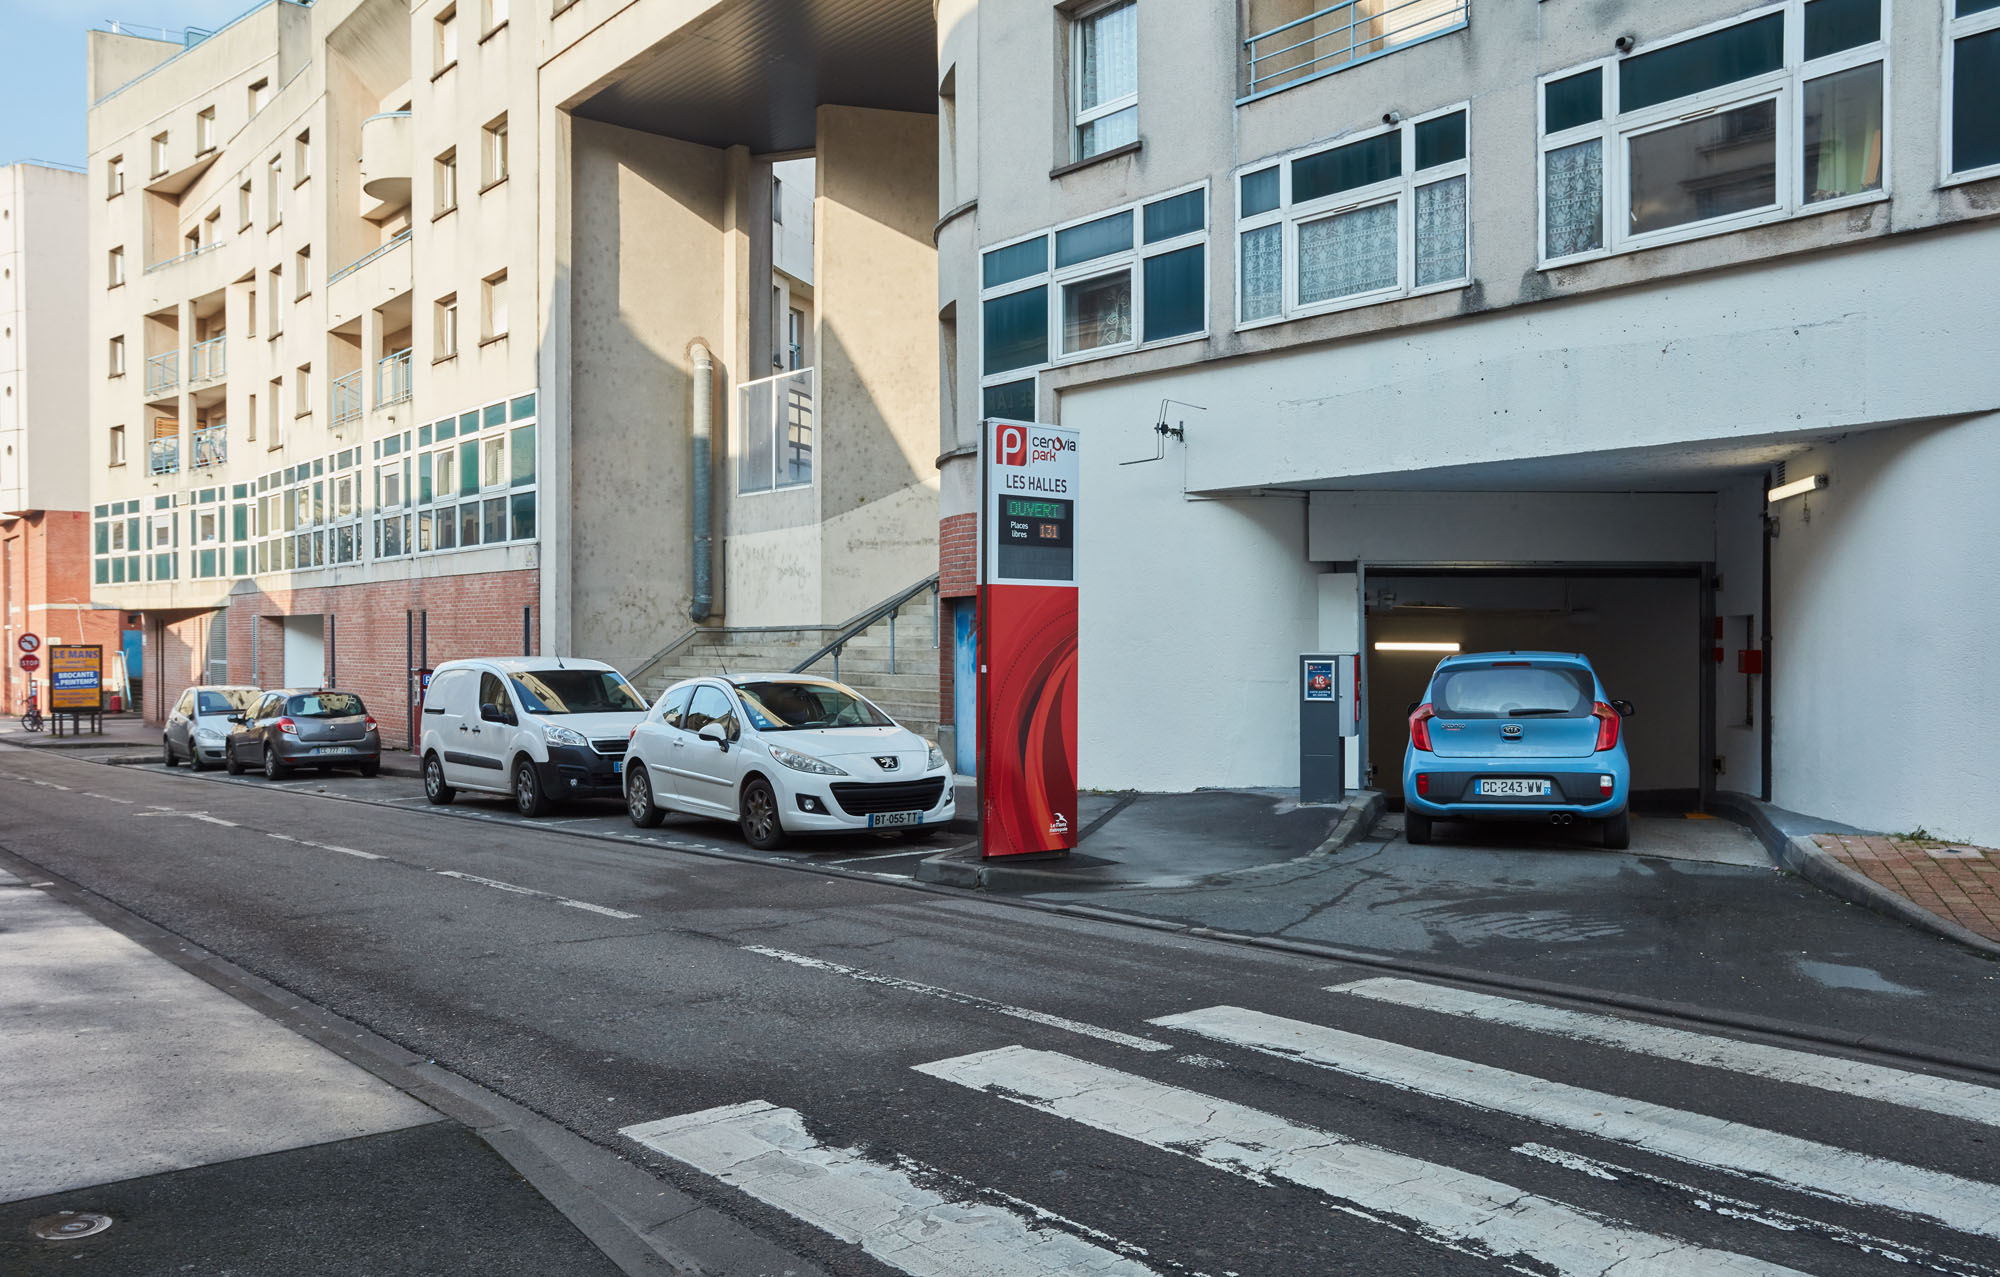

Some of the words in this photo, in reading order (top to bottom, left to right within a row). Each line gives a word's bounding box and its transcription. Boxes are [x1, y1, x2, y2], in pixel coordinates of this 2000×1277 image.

[1002, 428, 1021, 465] P
[1032, 436, 1076, 452] cenovia
[1032, 449, 1056, 463] park
[1006, 474, 1026, 490] LES
[1029, 476, 1067, 493] HALLES
[1009, 501, 1059, 518] OUVERT
[1010, 521, 1029, 530] Places
[1040, 524, 1058, 539] 131
[1011, 530, 1028, 538] libres
[53, 650, 65, 659] LE
[68, 650, 99, 659] MANS
[58, 671, 94, 679] BROCANTE
[1482, 781, 1543, 793] CC-243-WW
[875, 812, 918, 825] BT-055-TT
